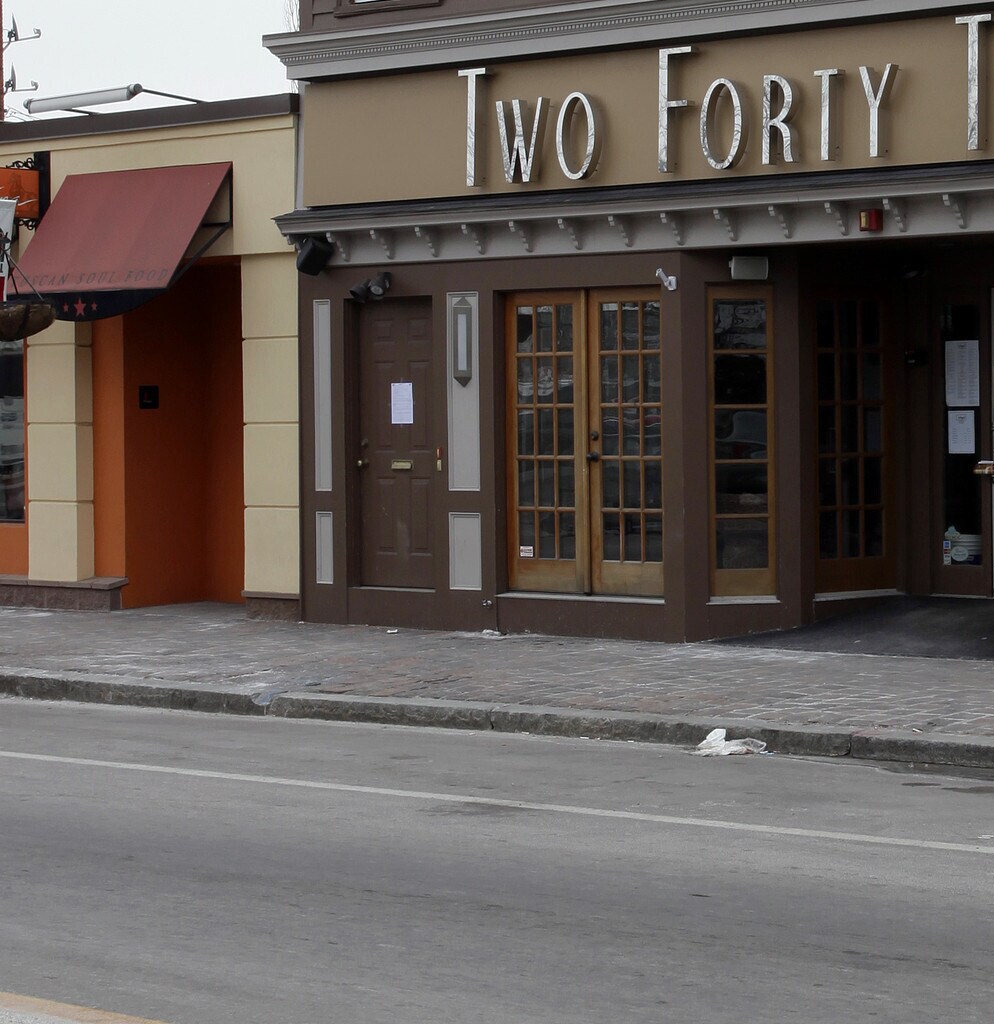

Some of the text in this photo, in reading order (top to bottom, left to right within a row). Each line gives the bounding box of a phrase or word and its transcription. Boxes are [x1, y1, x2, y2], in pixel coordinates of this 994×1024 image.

[457, 67, 599, 187] TWO
[658, 46, 900, 173] FORTY
[75, 271, 118, 285] SOUL
[123, 268, 168, 283] FOOD
